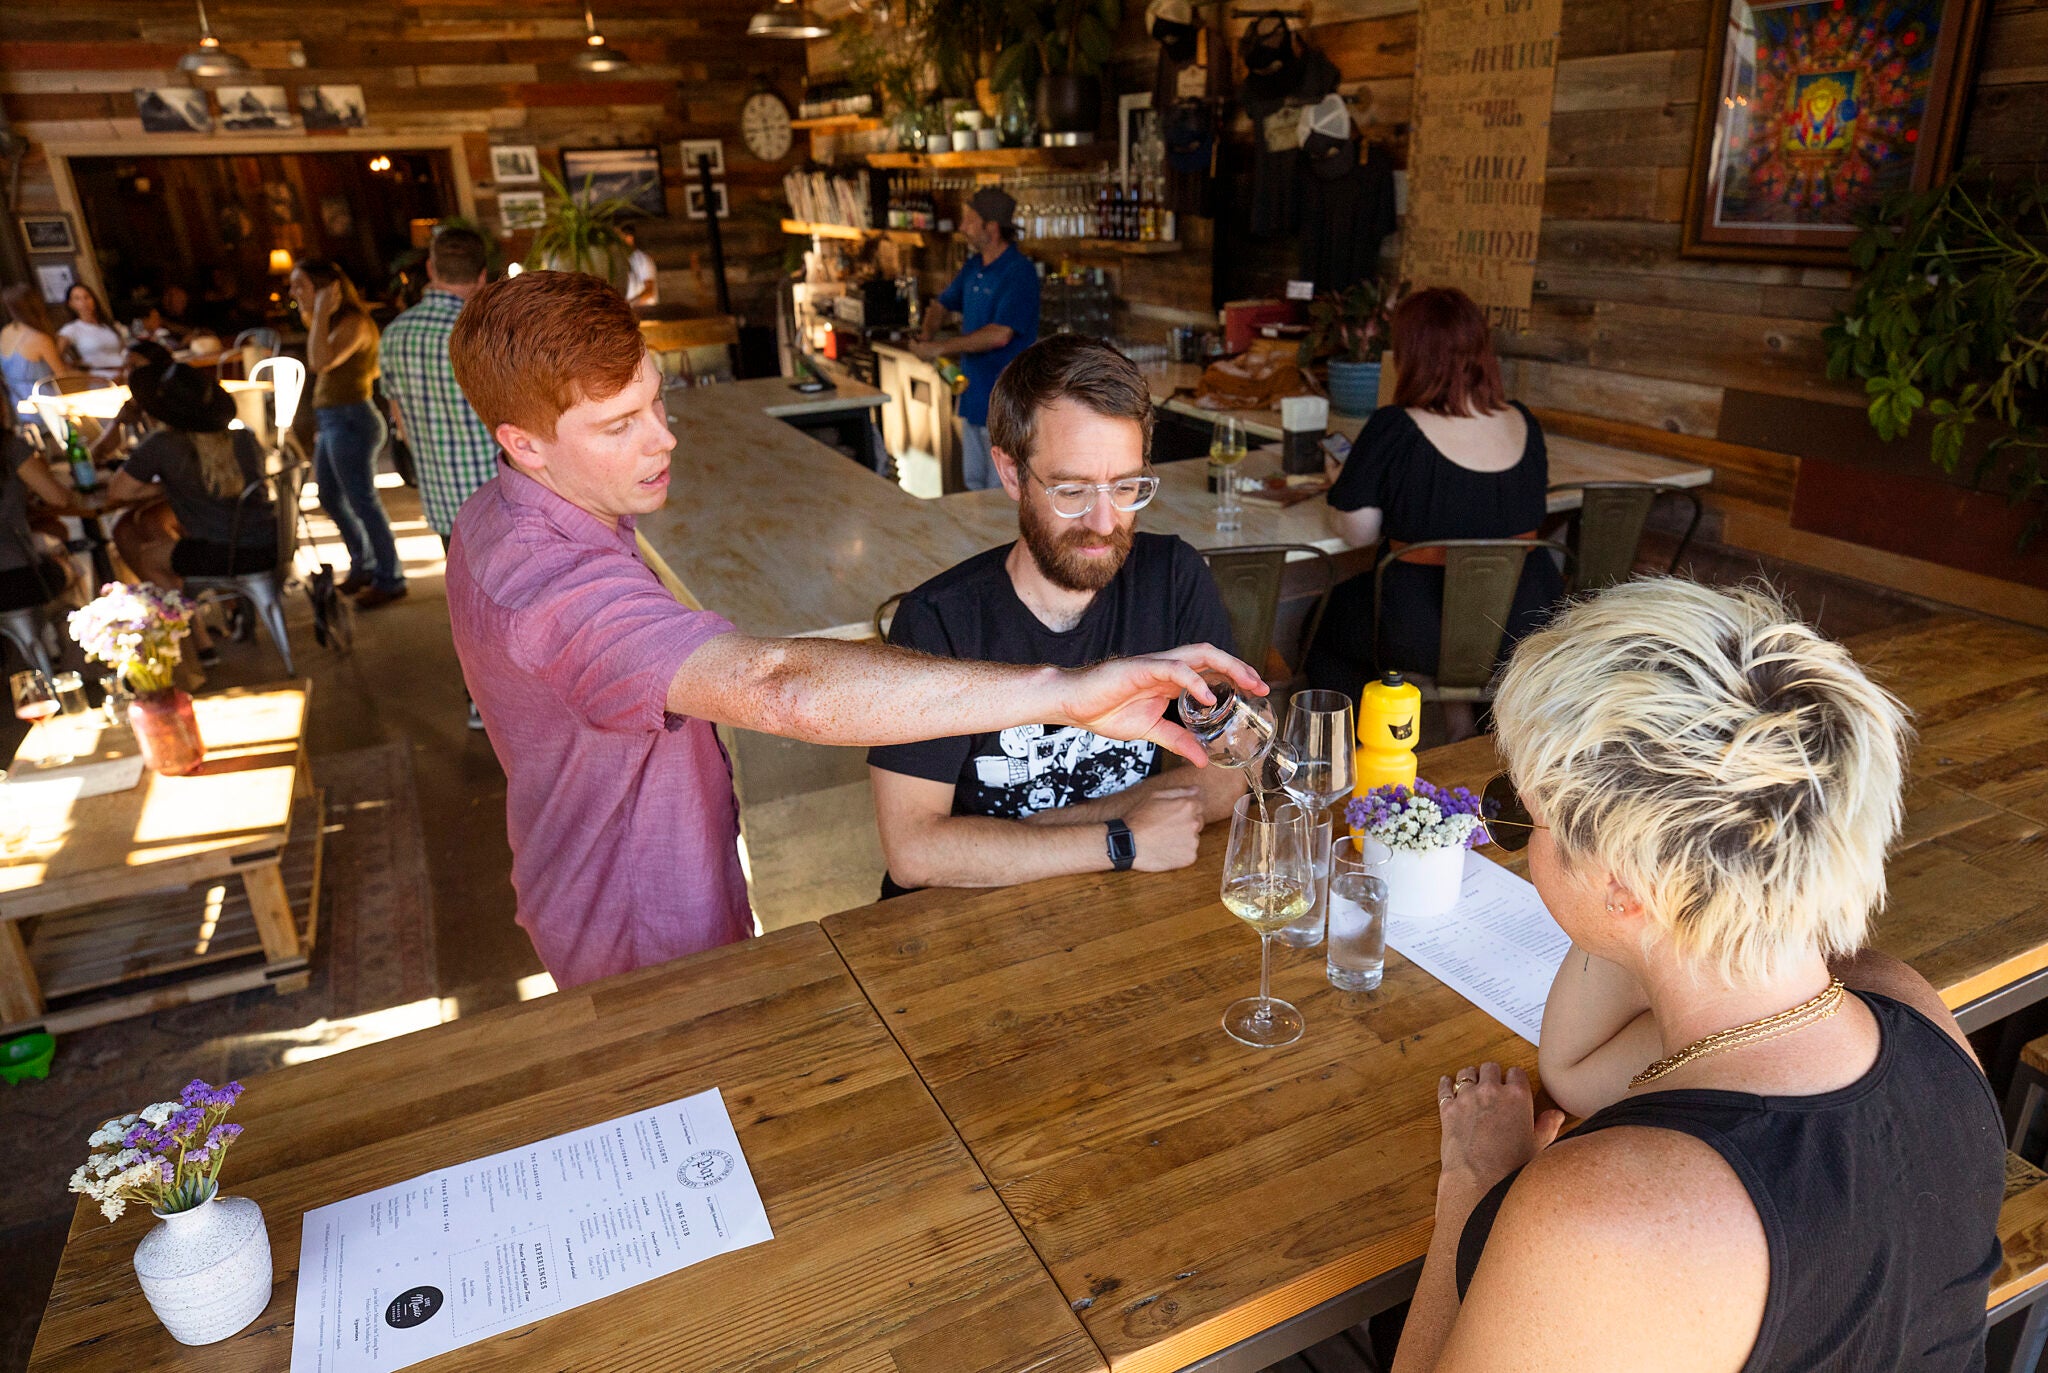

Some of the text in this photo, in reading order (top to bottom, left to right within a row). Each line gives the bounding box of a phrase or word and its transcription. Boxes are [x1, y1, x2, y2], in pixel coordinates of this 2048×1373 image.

[649, 1115, 669, 1164] TASTING FLIGHTS
[529, 1151, 537, 1163] THE
[617, 1138, 630, 1167] CALIFORNIA
[531, 1162, 541, 1187] CLASSICS
[691, 1155, 715, 1181] Pax
[440, 1177, 448, 1196] SYRAH
[674, 1201, 690, 1237] WINE CLUB
[516, 1242, 525, 1258] Private
[518, 1256, 527, 1274] Tasting
[533, 1241, 548, 1290] EXPERIENCES
[521, 1276, 530, 1292] Cellar
[522, 1290, 531, 1303] Tour
[408, 1291, 424, 1321] Music
